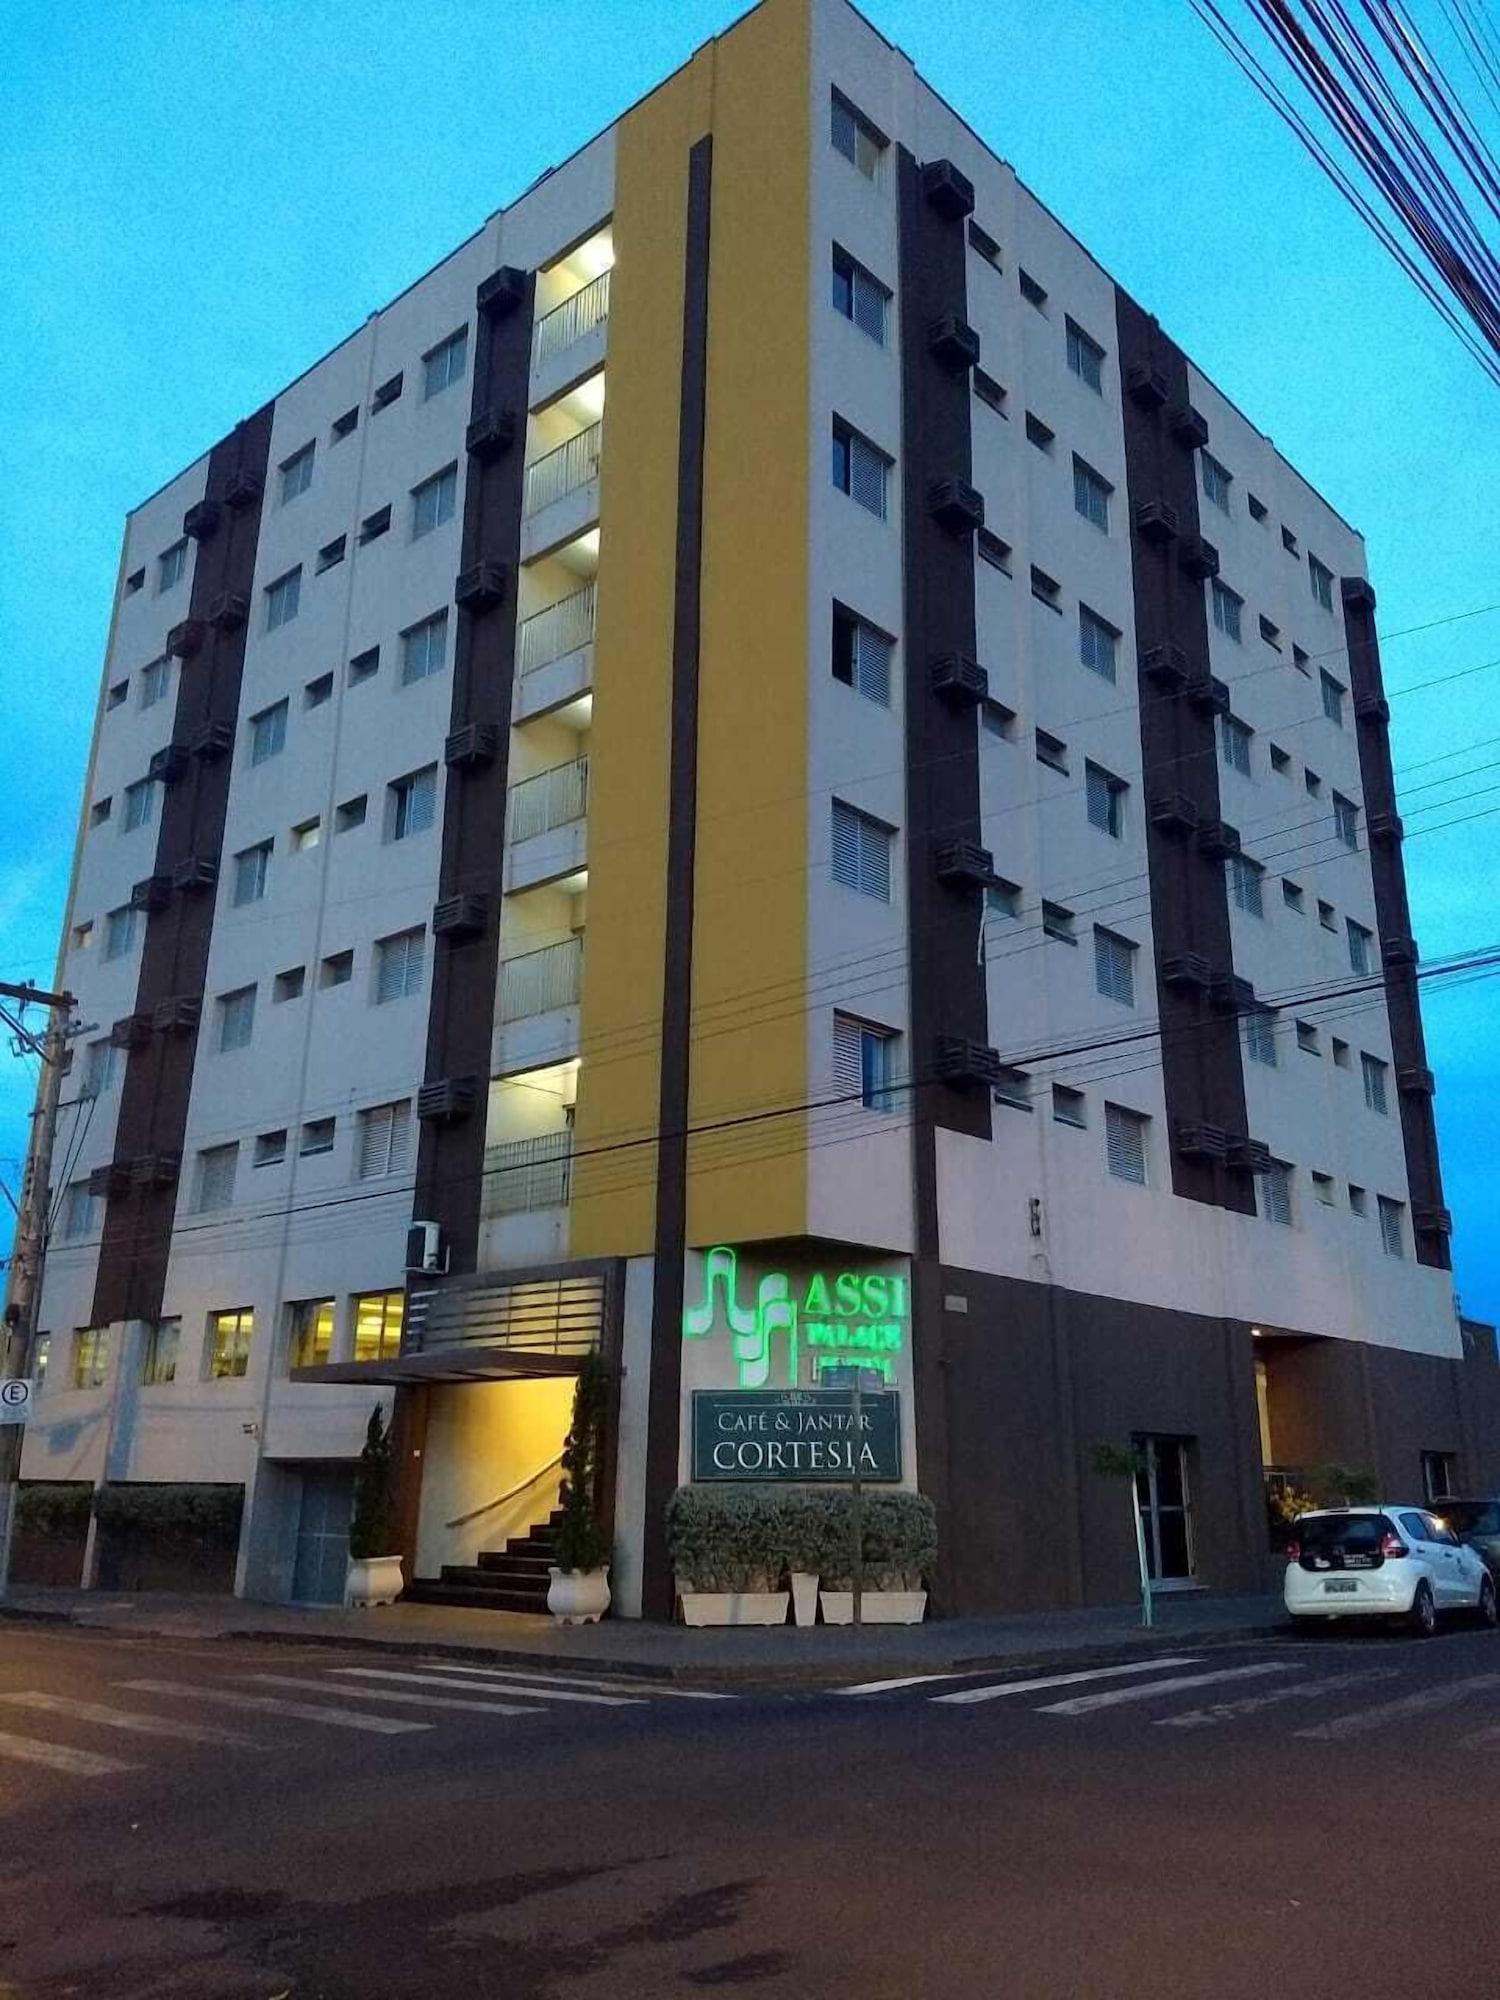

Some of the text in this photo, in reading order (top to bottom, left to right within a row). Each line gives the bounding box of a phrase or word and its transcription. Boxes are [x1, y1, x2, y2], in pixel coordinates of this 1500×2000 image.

[803, 1273, 907, 1318] ASSI
[10, 1385, 20, 1401] E
[718, 1411, 874, 1434] CAFÉ & JANTAR
[712, 1440, 879, 1470] CORTESIA
